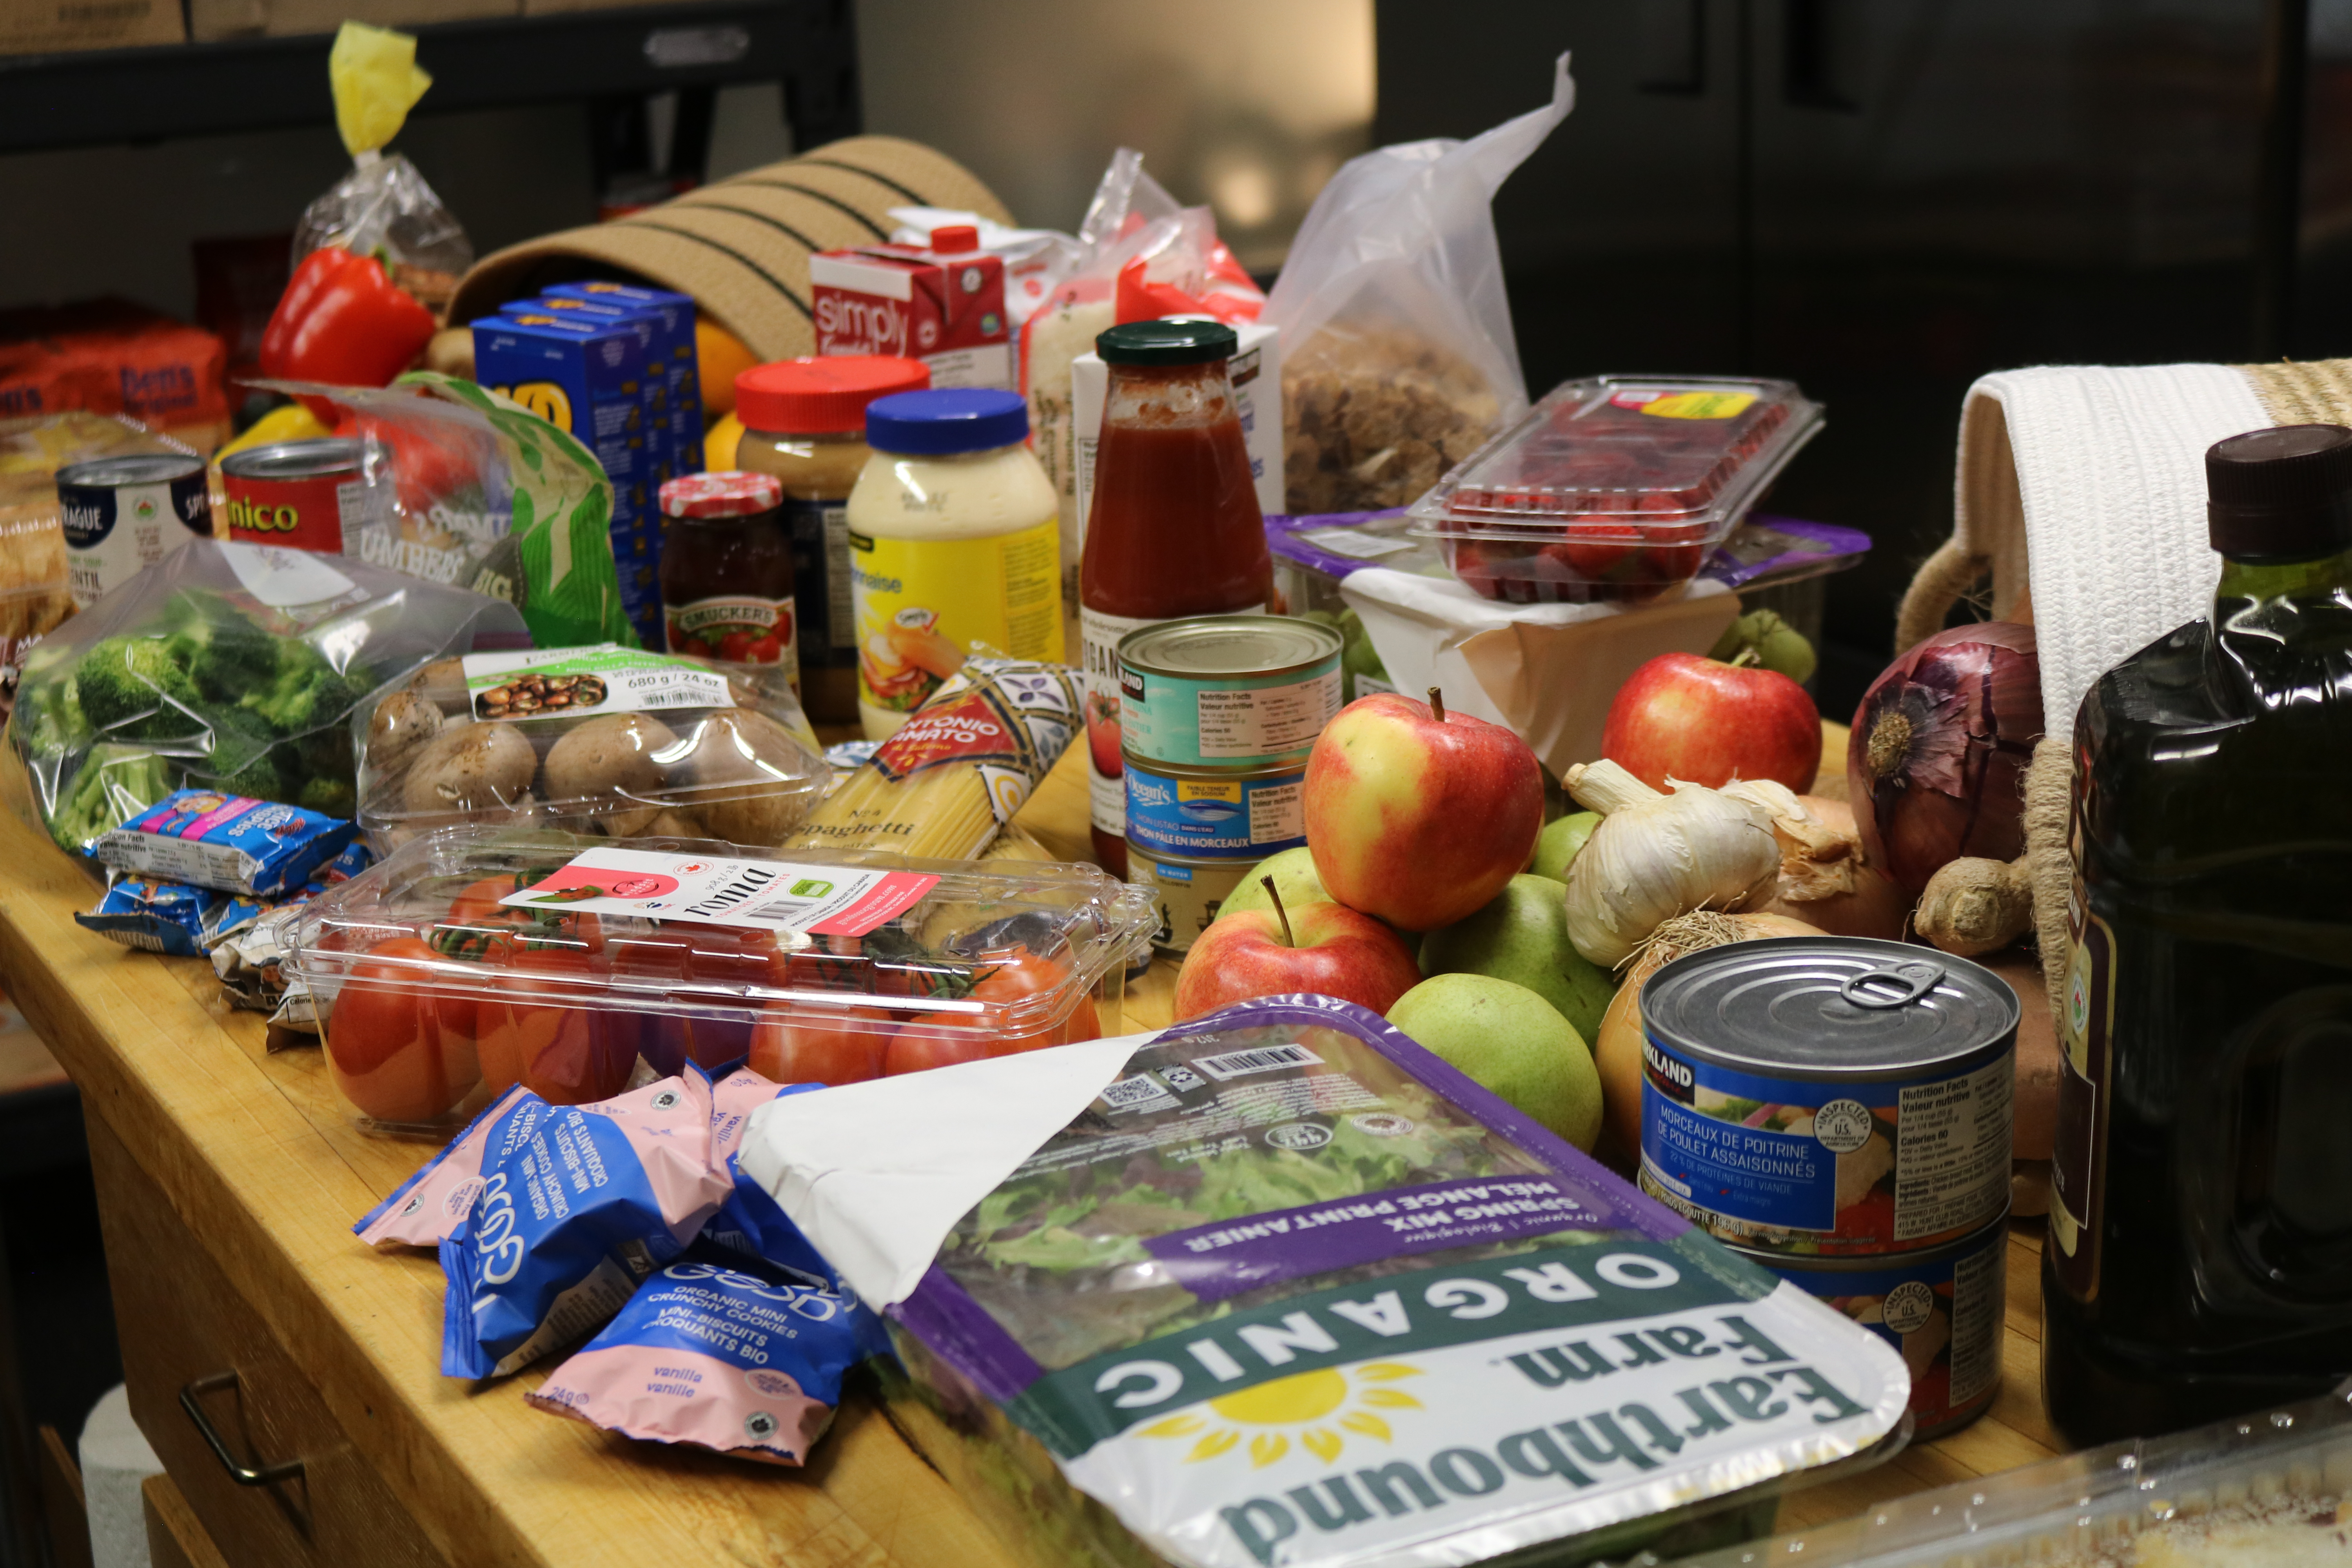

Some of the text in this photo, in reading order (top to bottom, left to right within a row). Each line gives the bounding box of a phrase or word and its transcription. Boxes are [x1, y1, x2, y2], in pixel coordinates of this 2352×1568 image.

[816, 290, 909, 359] simply
[229, 494, 299, 532] nico
[360, 523, 465, 583] UMBERS
[628, 677, 656, 689] 680
[660, 676, 670, 687] g
[682, 673, 701, 683] 24
[1120, 667, 1143, 691] LAND
[904, 716, 999, 736] NTONIO
[1128, 774, 1171, 806] Ocean's
[120, 844, 147, 853] nutritive
[128, 834, 145, 843] Facts
[1136, 824, 1249, 848] THON PÂLE EN MORCEAUX
[684, 867, 777, 917] roma
[715, 900, 755, 919] TOMATOES
[757, 873, 791, 897] TOMATES
[1642, 1039, 1692, 1087] RKLAND
[1902, 1078, 1969, 1100] Nutrition Facts
[1902, 1091, 1971, 1114] Valeur nutritive
[1817, 1102, 1869, 1125] INSPECTED
[1835, 1123, 1851, 1135] U.S.
[566, 1111, 609, 1188] CROQUANTS BIO
[1658, 1120, 1668, 1135] DE
[1670, 1127, 1708, 1157] POULET
[1711, 1146, 1815, 1179] ASSAISONNÉS
[1660, 1104, 1809, 1160] MORCEAUX DE POITRINE
[1901, 1133, 1936, 1147] Calories
[521, 1154, 537, 1181] MINI
[530, 1131, 570, 1219] CRUNCHY COOKIES
[554, 1123, 591, 1194] MINI-BISCUITS
[1686, 1159, 1696, 1170] DE
[1697, 1162, 1742, 1187] PROTÉINES
[1743, 1178, 1756, 1189] DE
[1758, 1181, 1792, 1195] VIANDE
[527, 1175, 550, 1220] ORGANIC
[1382, 1196, 1580, 1232] SPRING MIX
[1661, 1191, 1677, 1210] POIDS
[1678, 1198, 1710, 1225] ÉGOUTTÉ
[1898, 1210, 1928, 1220] PREPARED
[1183, 1181, 1559, 1252] MÉLANGE PRINTANIER
[673, 1286, 788, 1324] ORGANIC MINI
[1885, 1283, 1932, 1310] INSPECTED
[1902, 1304, 1916, 1318] U.S.
[648, 1293, 799, 1339] CRUNCHY COOKIES
[659, 1305, 769, 1347] MINI-BISCUITS
[1095, 1253, 1680, 1408] ORGANIC
[740, 1345, 769, 1365] BIO
[1507, 1316, 1799, 1388] Farm
[646, 1382, 695, 1398] vanille
[654, 1366, 703, 1383] vanilla
[1220, 1367, 1876, 1566] Earthbound
